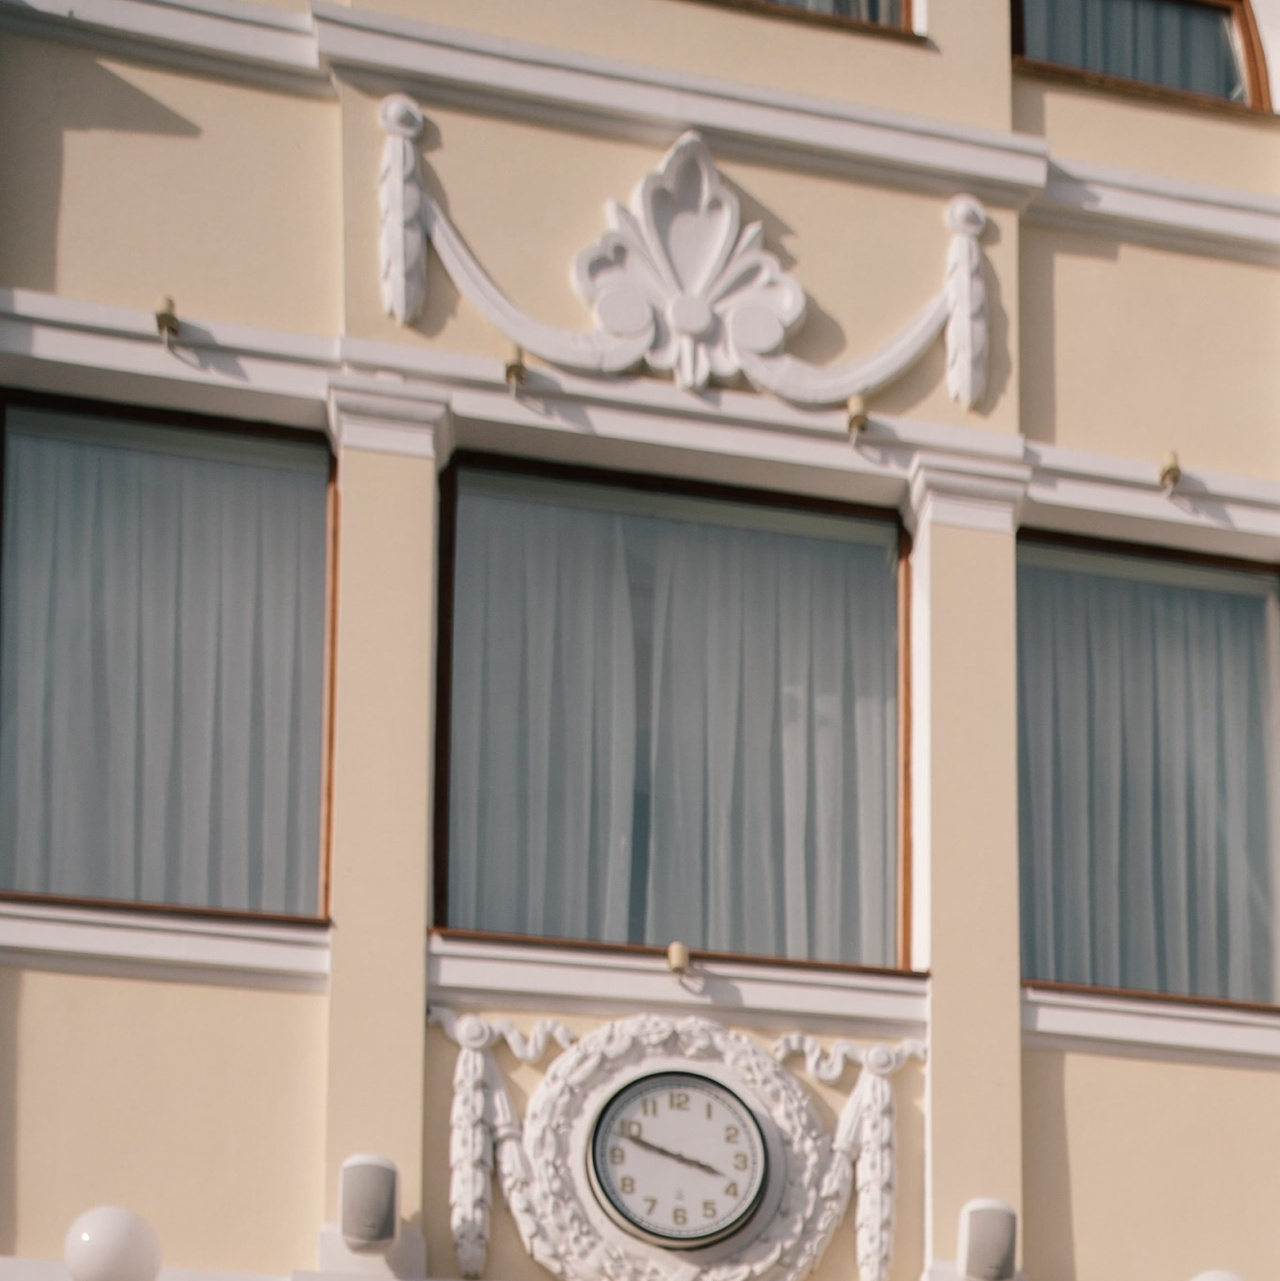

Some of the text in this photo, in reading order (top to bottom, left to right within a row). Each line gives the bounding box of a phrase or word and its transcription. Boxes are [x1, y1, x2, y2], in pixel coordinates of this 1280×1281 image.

[642, 1099, 657, 1116] 11
[669, 1092, 690, 1110] 12
[706, 1102, 712, 1119] 1
[620, 1119, 643, 1138] 10
[725, 1126, 739, 1143] 2
[610, 1147, 625, 1165] 9
[734, 1153, 748, 1171] 3
[620, 1176, 635, 1195] 8
[724, 1181, 739, 1198] 4
[644, 1199, 658, 1215] 7
[703, 1201, 716, 1218] 5
[672, 1207, 687, 1226] 6
